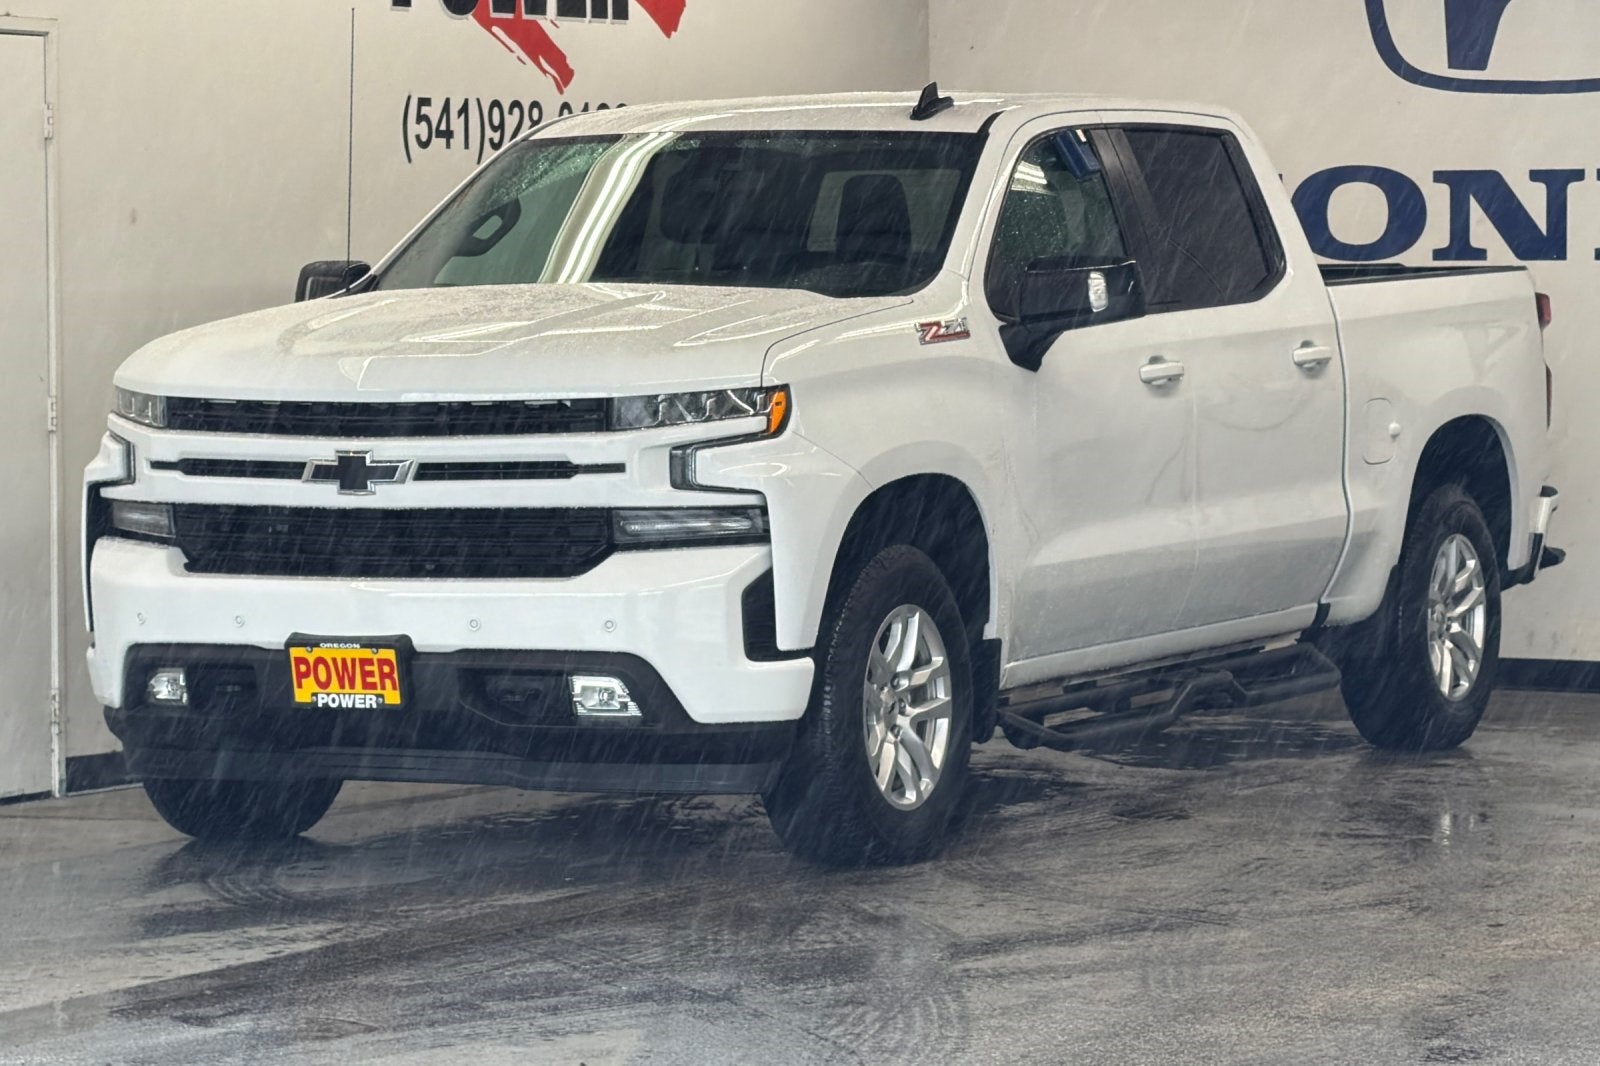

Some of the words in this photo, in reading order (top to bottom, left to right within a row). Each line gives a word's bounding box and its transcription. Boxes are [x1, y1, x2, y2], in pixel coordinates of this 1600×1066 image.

[402, 94, 628, 164] (541)928
[1278, 164, 1600, 261] ON
[293, 656, 399, 691] POWER
[317, 693, 378, 709] POWER
